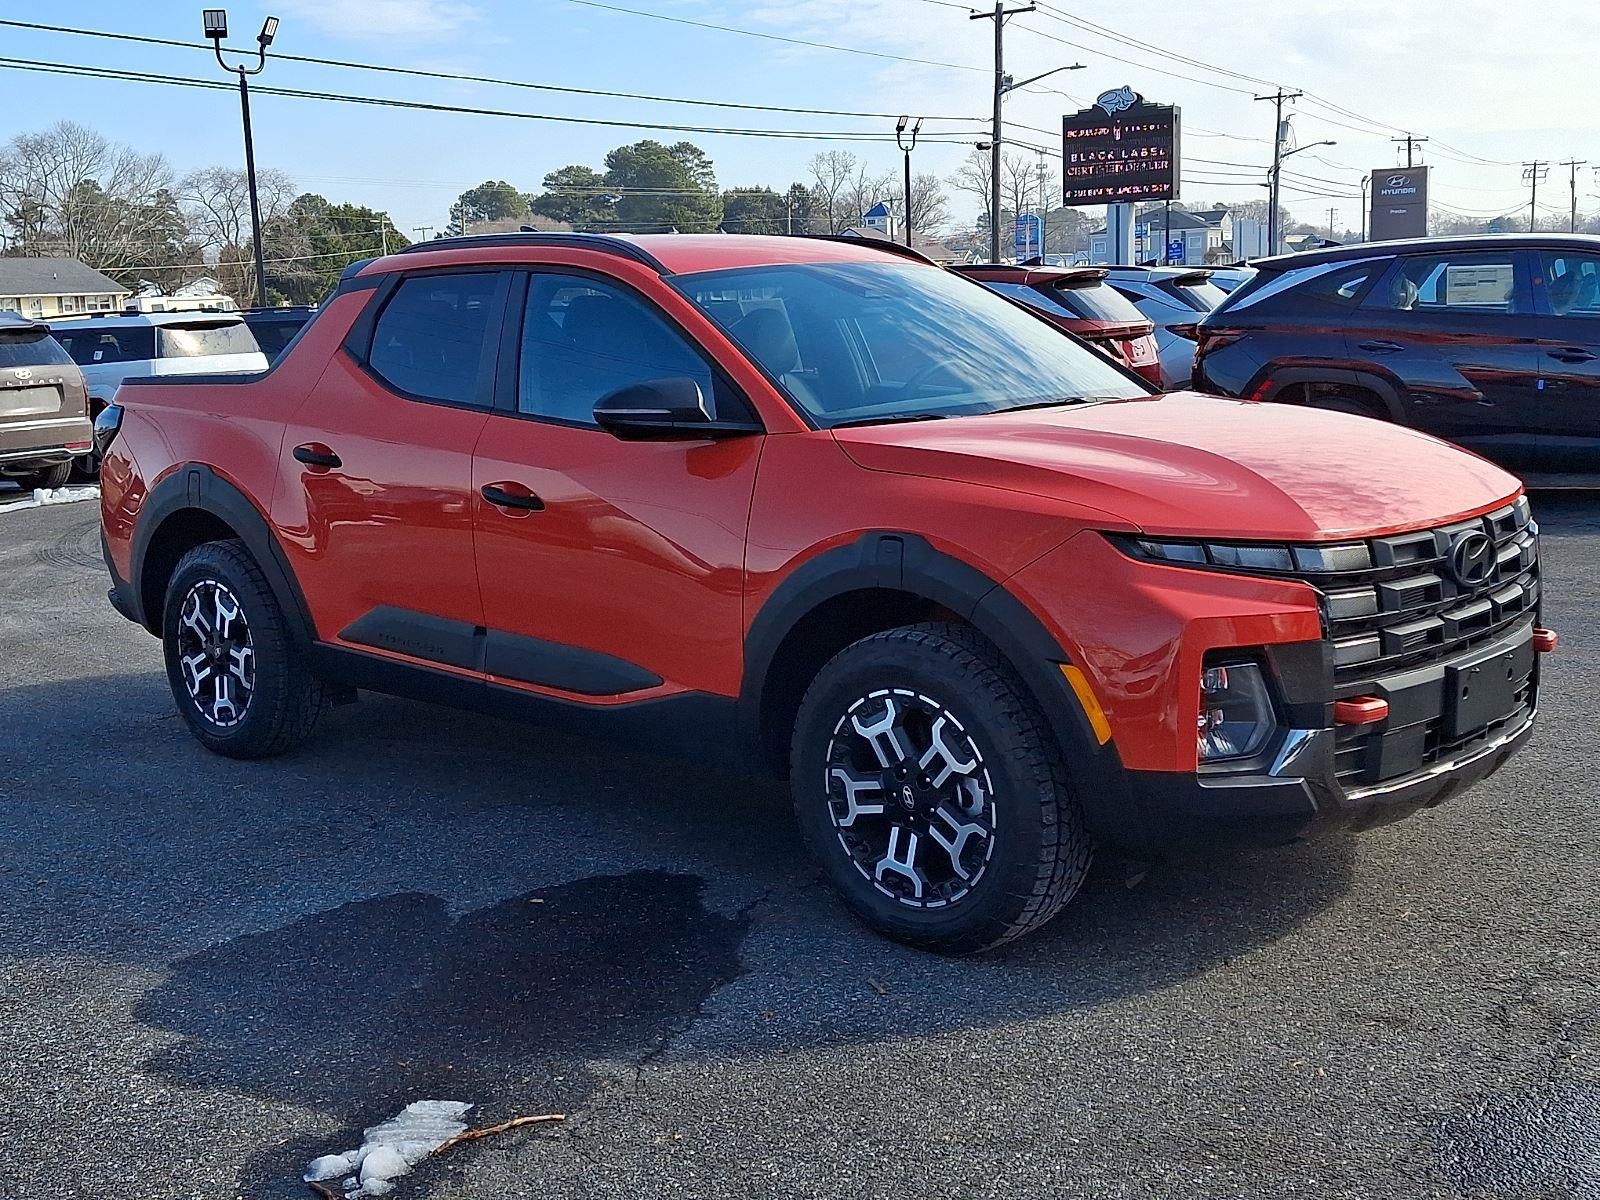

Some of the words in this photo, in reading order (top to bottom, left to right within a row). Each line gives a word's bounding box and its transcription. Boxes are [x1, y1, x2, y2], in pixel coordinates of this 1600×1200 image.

[1071, 150, 1115, 163] BLACK
[1121, 147, 1166, 159] LABEL
[1382, 187, 1415, 195] HYUNDAI
